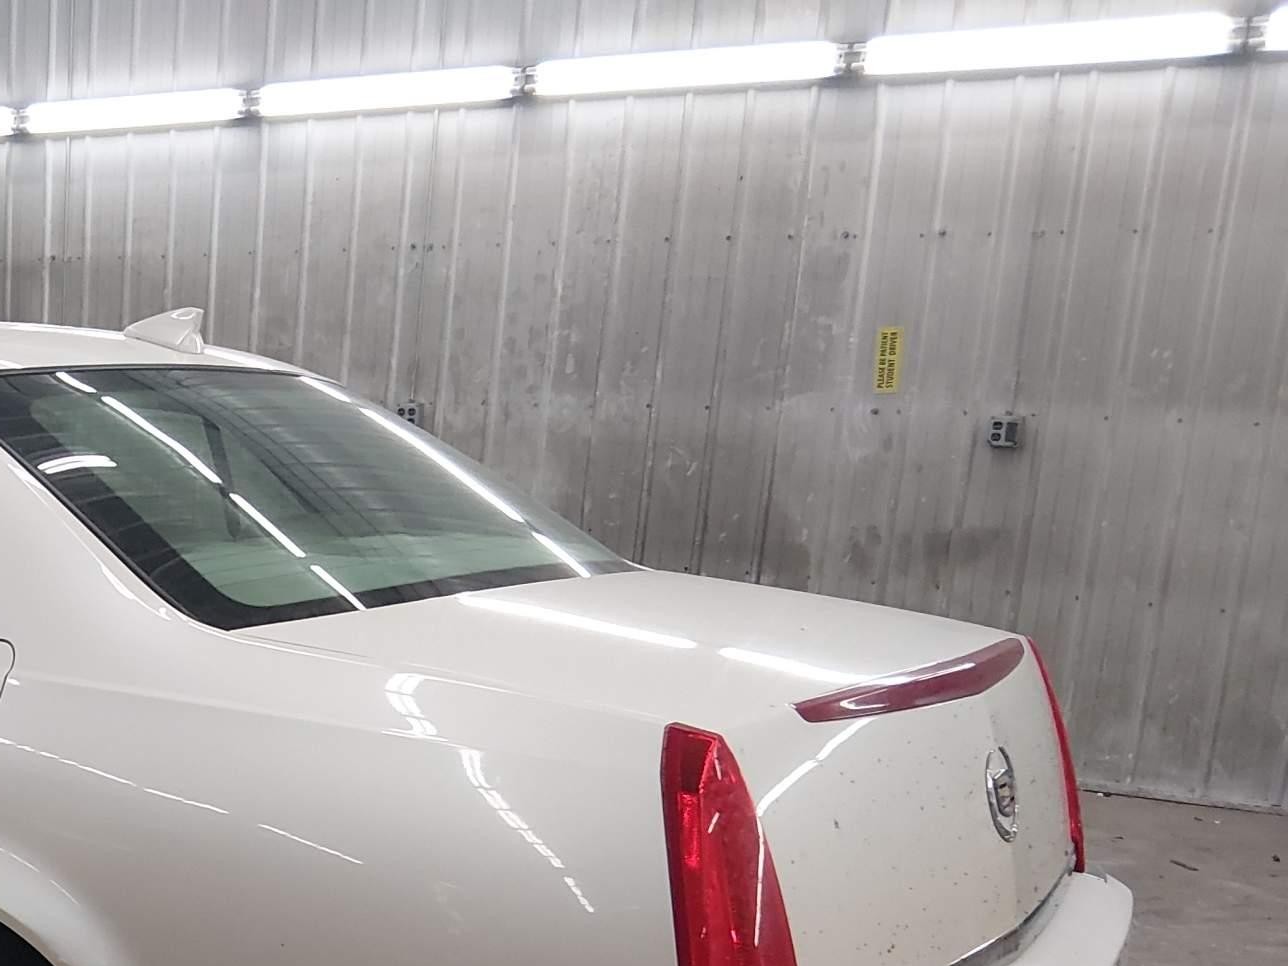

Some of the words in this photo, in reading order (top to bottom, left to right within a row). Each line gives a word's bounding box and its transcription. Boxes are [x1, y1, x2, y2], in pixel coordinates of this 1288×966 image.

[880, 331, 889, 357] PATIENT
[888, 331, 899, 356] DRIVER
[879, 358, 887, 366] BE
[885, 359, 896, 389] STUDENT
[877, 367, 885, 389] PLEASE
